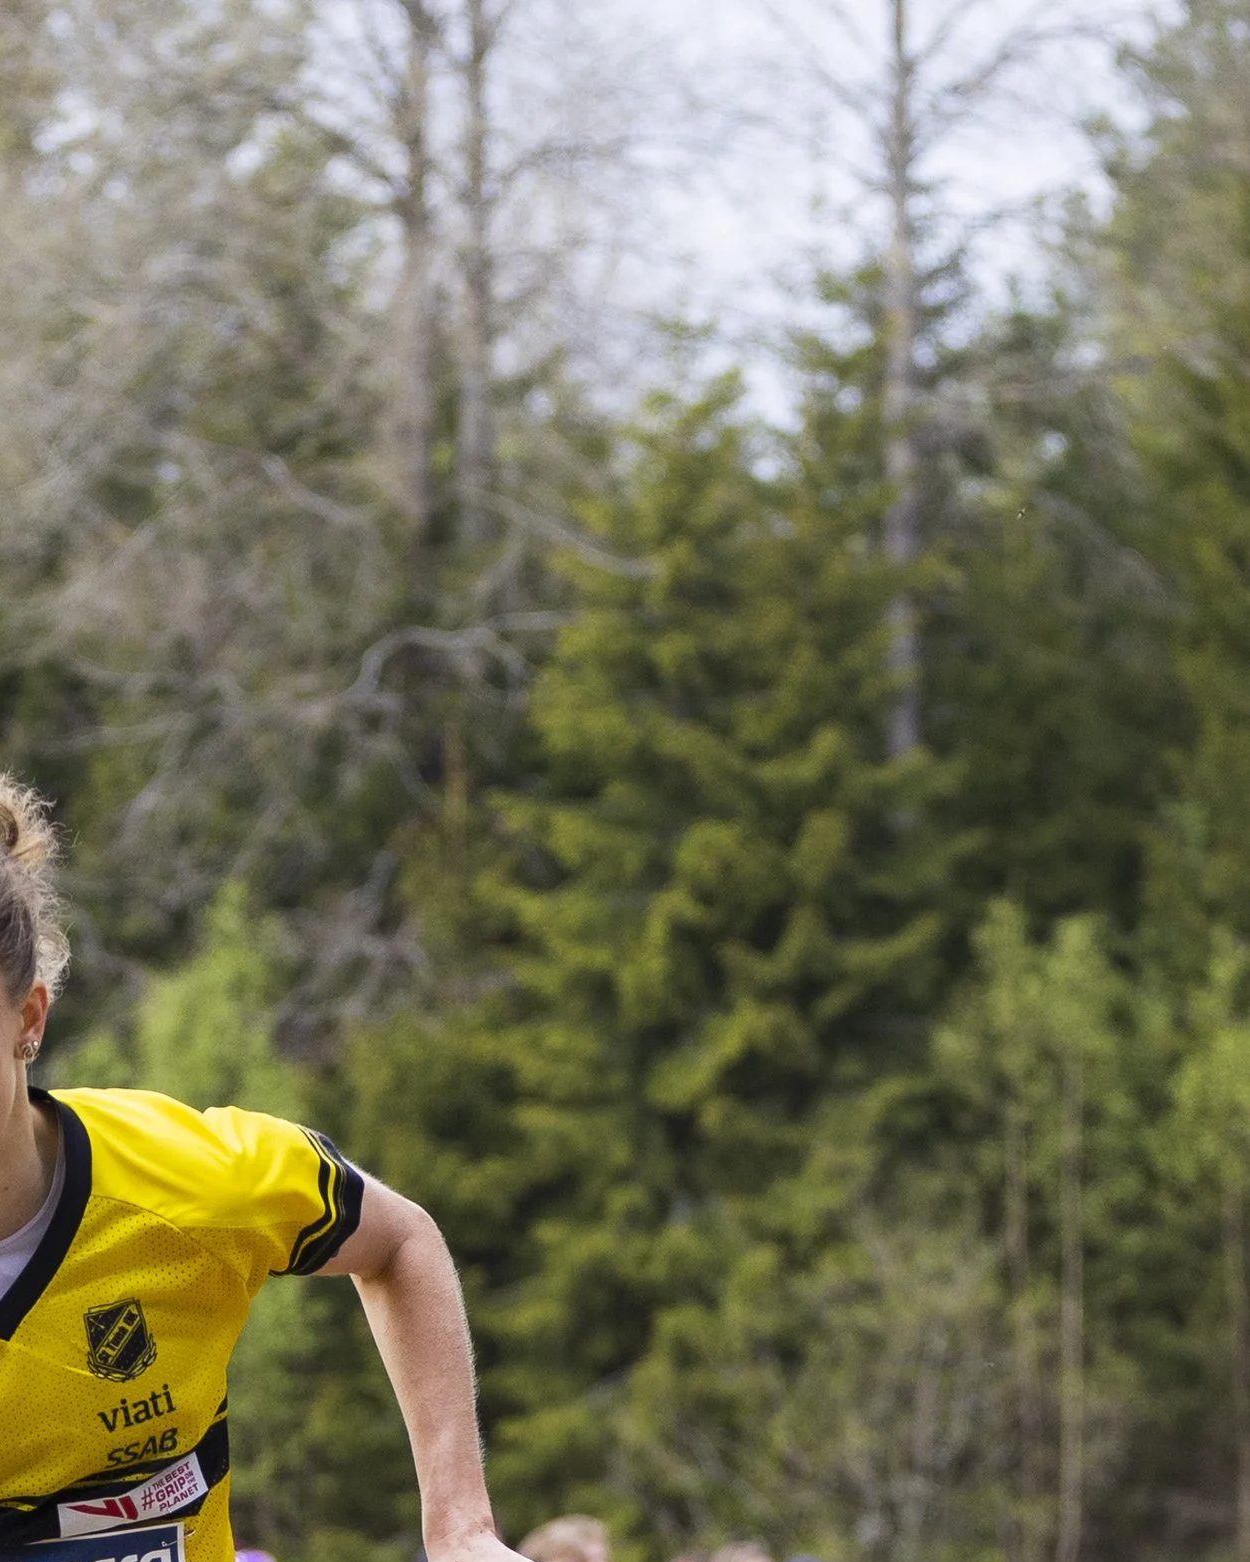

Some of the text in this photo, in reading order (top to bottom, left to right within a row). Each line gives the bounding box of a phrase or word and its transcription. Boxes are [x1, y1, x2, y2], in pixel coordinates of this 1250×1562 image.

[97, 1383, 176, 1433] viati
[105, 1427, 178, 1469] SSAB
[152, 1461, 190, 1491] THE BEST
[158, 1482, 199, 1511] PLANET
